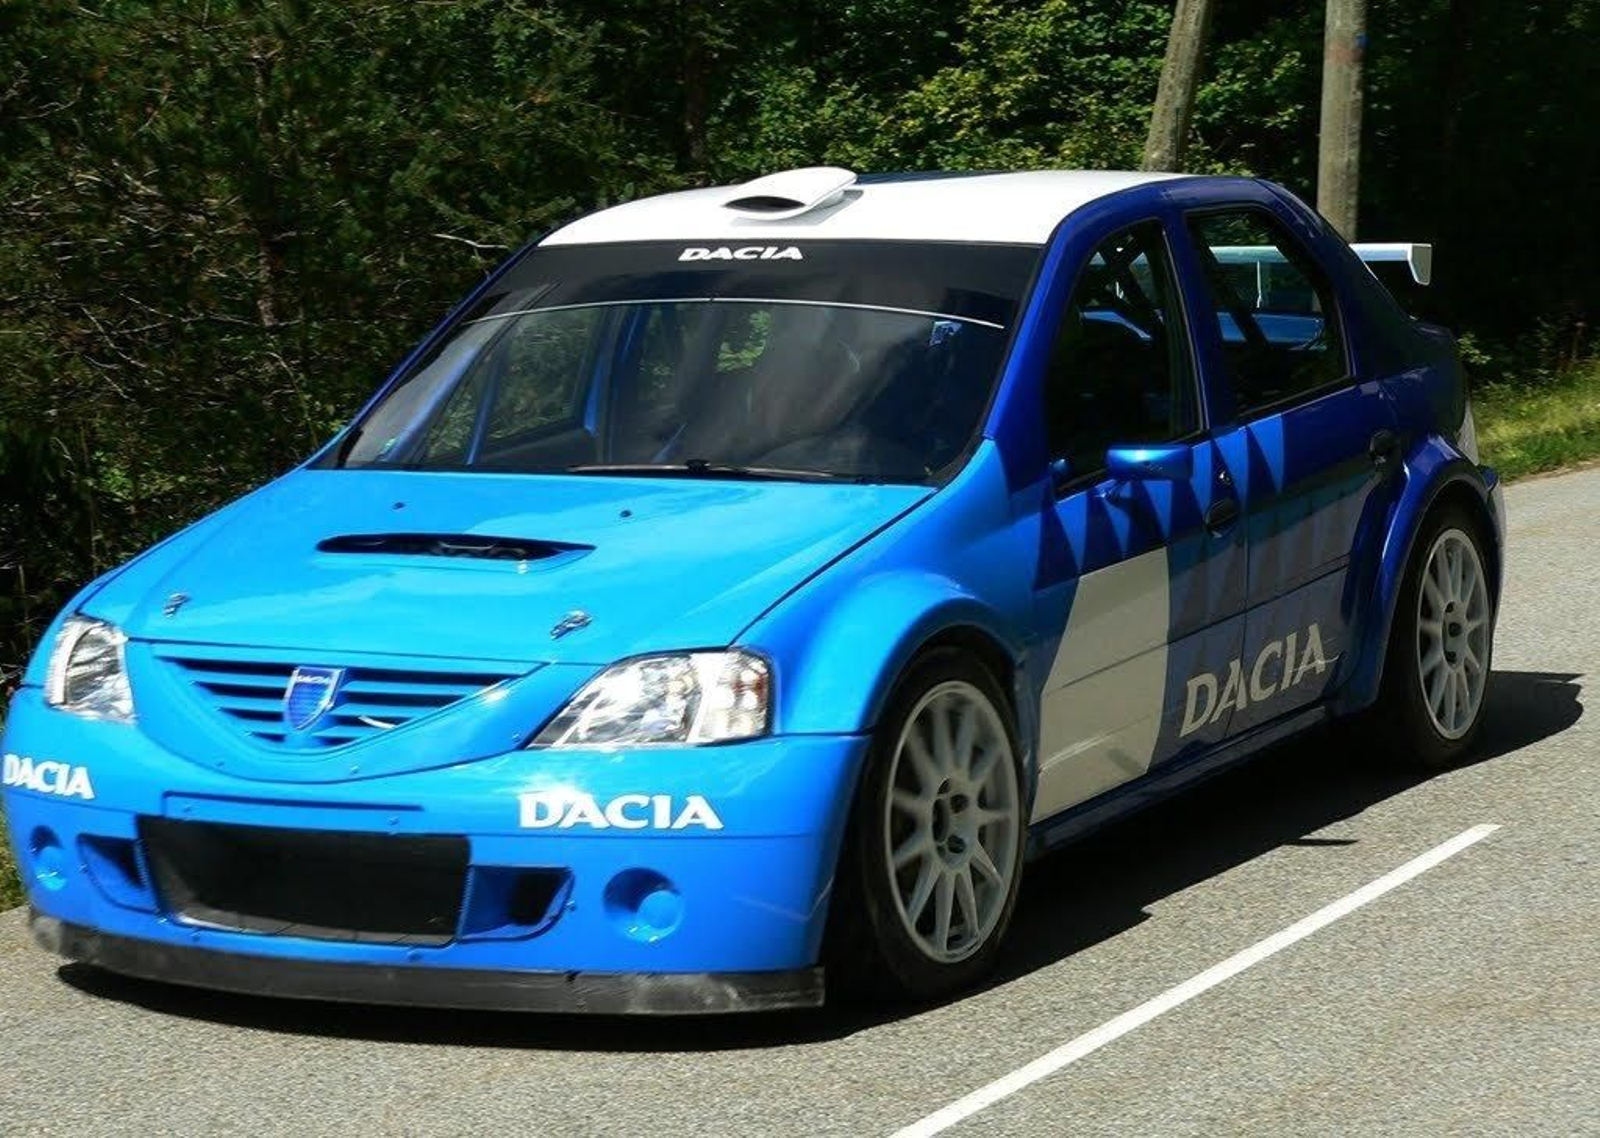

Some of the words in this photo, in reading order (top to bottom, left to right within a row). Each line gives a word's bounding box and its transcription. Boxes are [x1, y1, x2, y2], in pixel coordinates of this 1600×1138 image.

[678, 246, 803, 261] DACIA
[1179, 623, 1325, 738] DACIA
[2, 754, 95, 800] DACIA
[519, 794, 725, 829] DACIA
